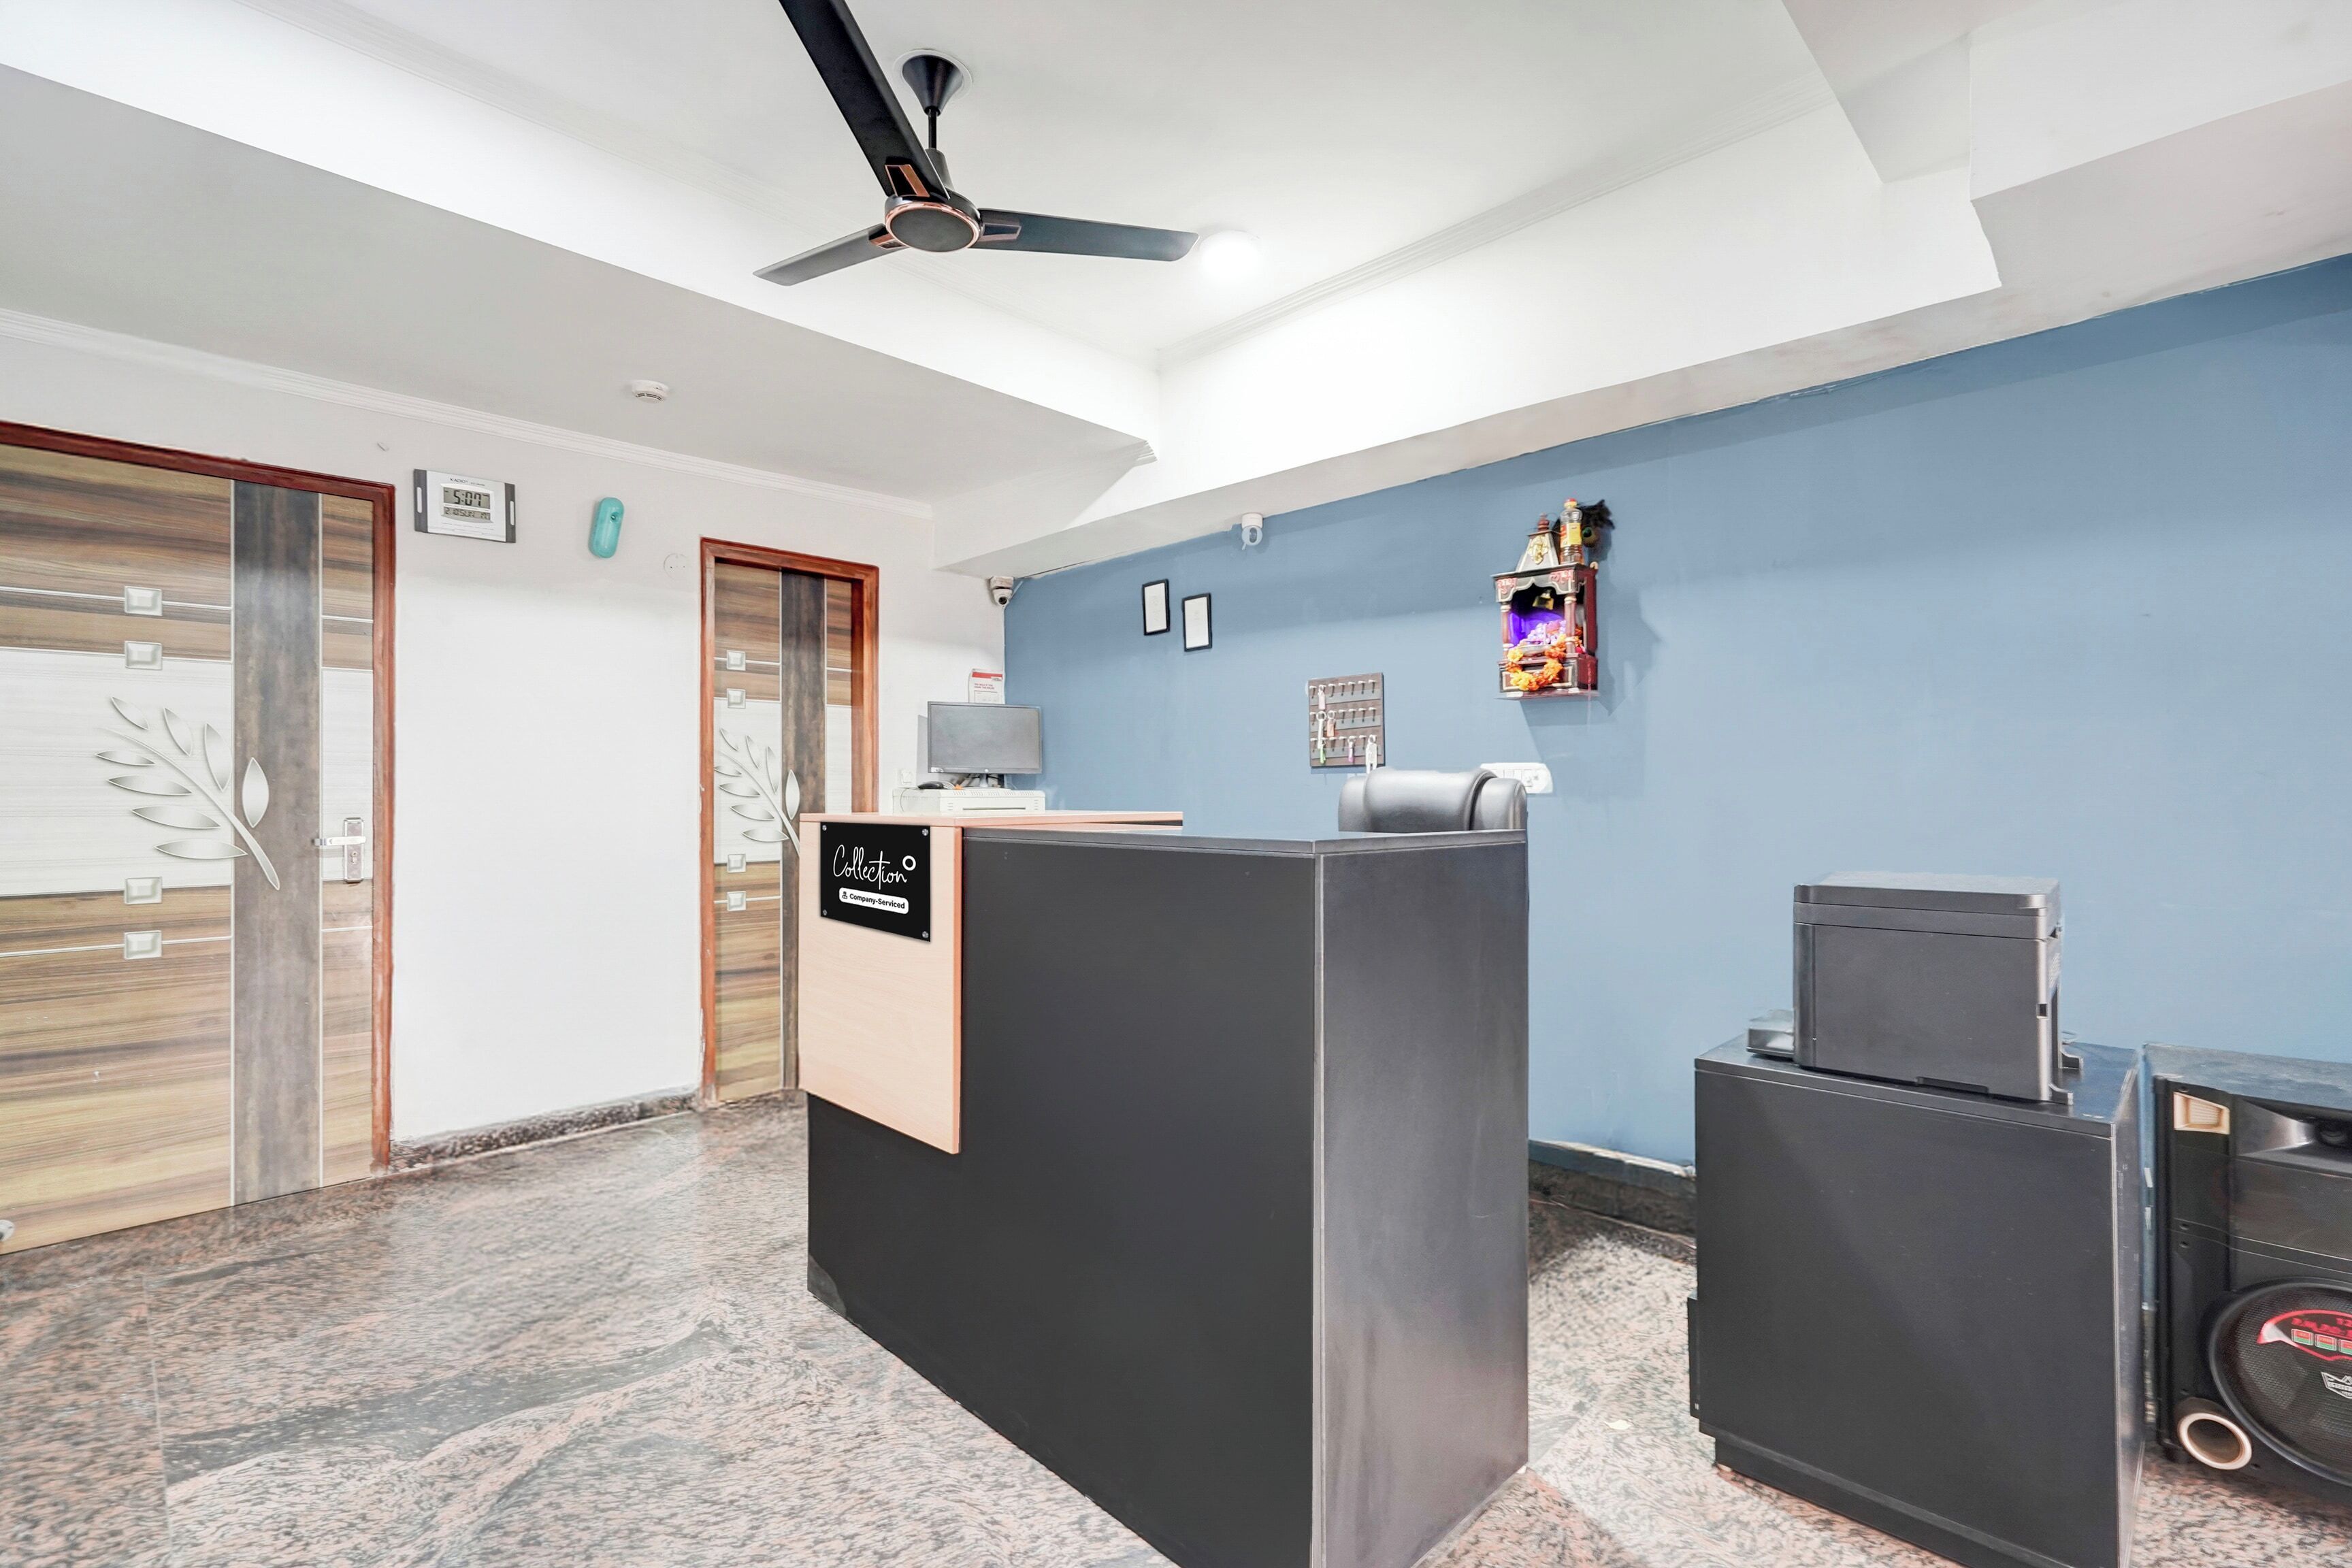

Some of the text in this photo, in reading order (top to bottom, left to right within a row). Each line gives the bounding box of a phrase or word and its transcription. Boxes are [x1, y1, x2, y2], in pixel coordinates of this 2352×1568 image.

[453, 490, 480, 506] 5:07
[833, 844, 907, 891] Collection
[849, 893, 905, 909] Company-Serviced
